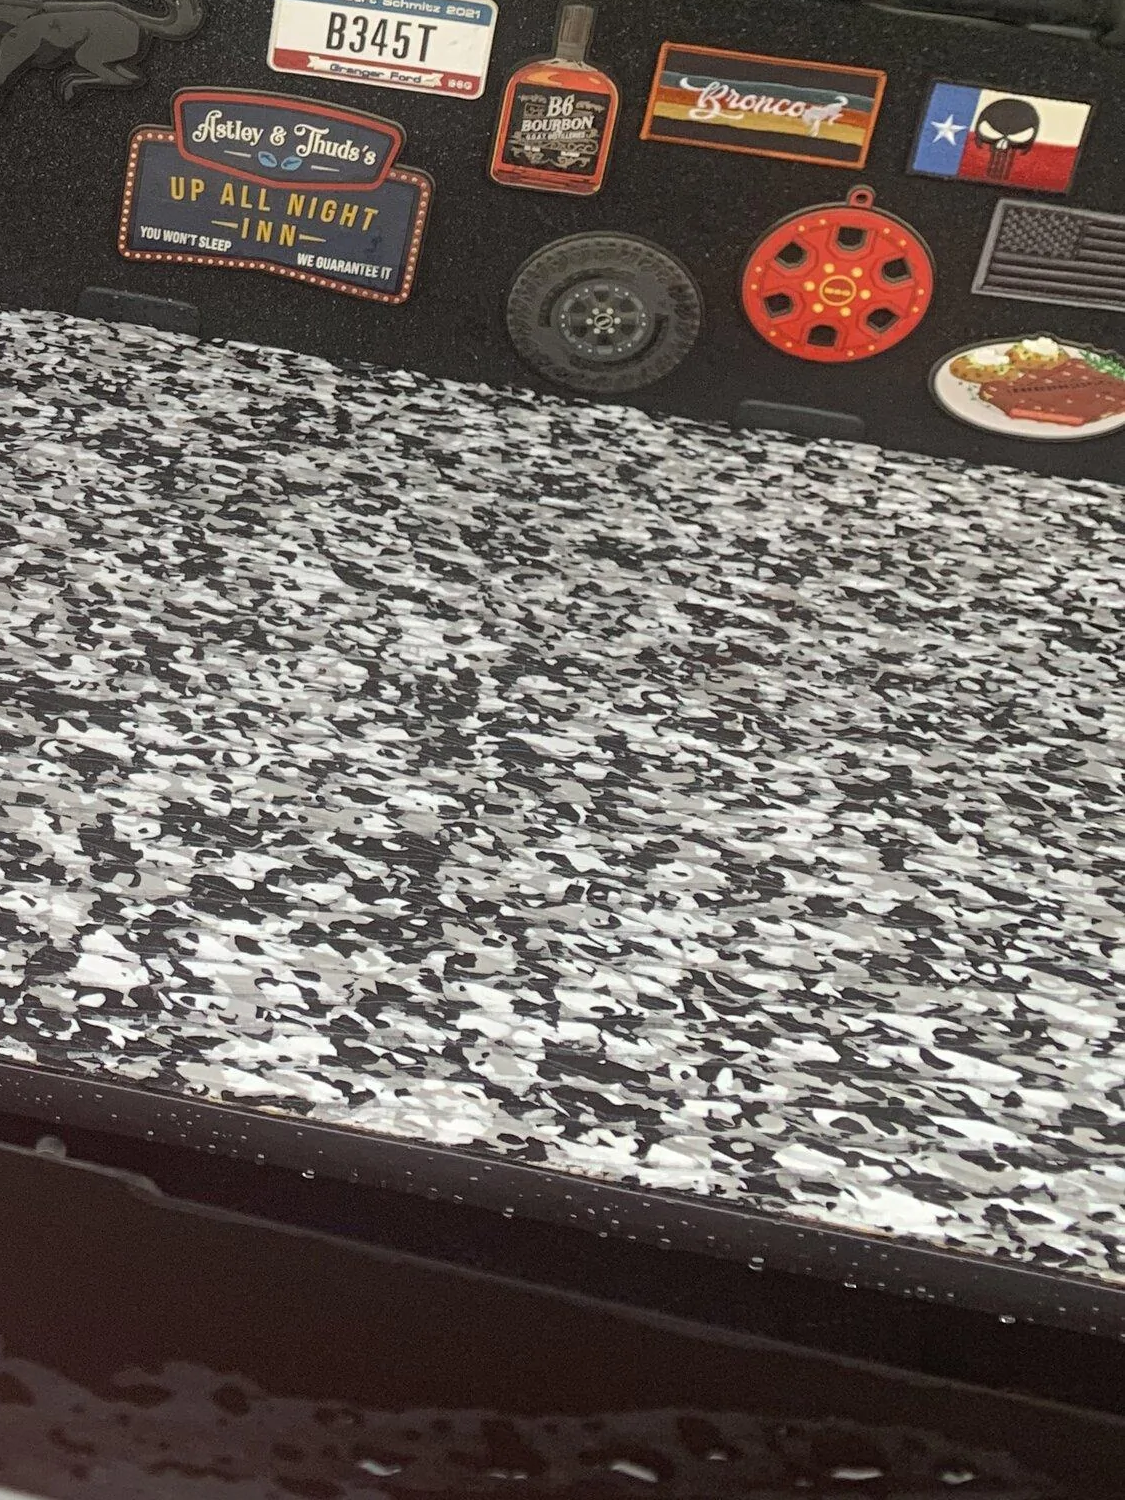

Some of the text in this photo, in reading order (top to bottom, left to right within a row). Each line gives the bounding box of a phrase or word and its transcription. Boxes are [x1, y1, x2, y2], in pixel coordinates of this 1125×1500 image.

[446, 6, 481, 20] 2021
[326, 11, 437, 62] B345T
[330, 62, 422, 84] Granger Ford
[680, 78, 806, 120] Bronco
[192, 110, 377, 166] Astley & Thuds's
[521, 115, 595, 132] BOURBON
[170, 176, 379, 232] UP ALL NIGHT
[141, 225, 232, 252] YOU WON'T SLEEP
[241, 217, 297, 247] INN
[297, 252, 392, 281] WE GUARANTEE IT
